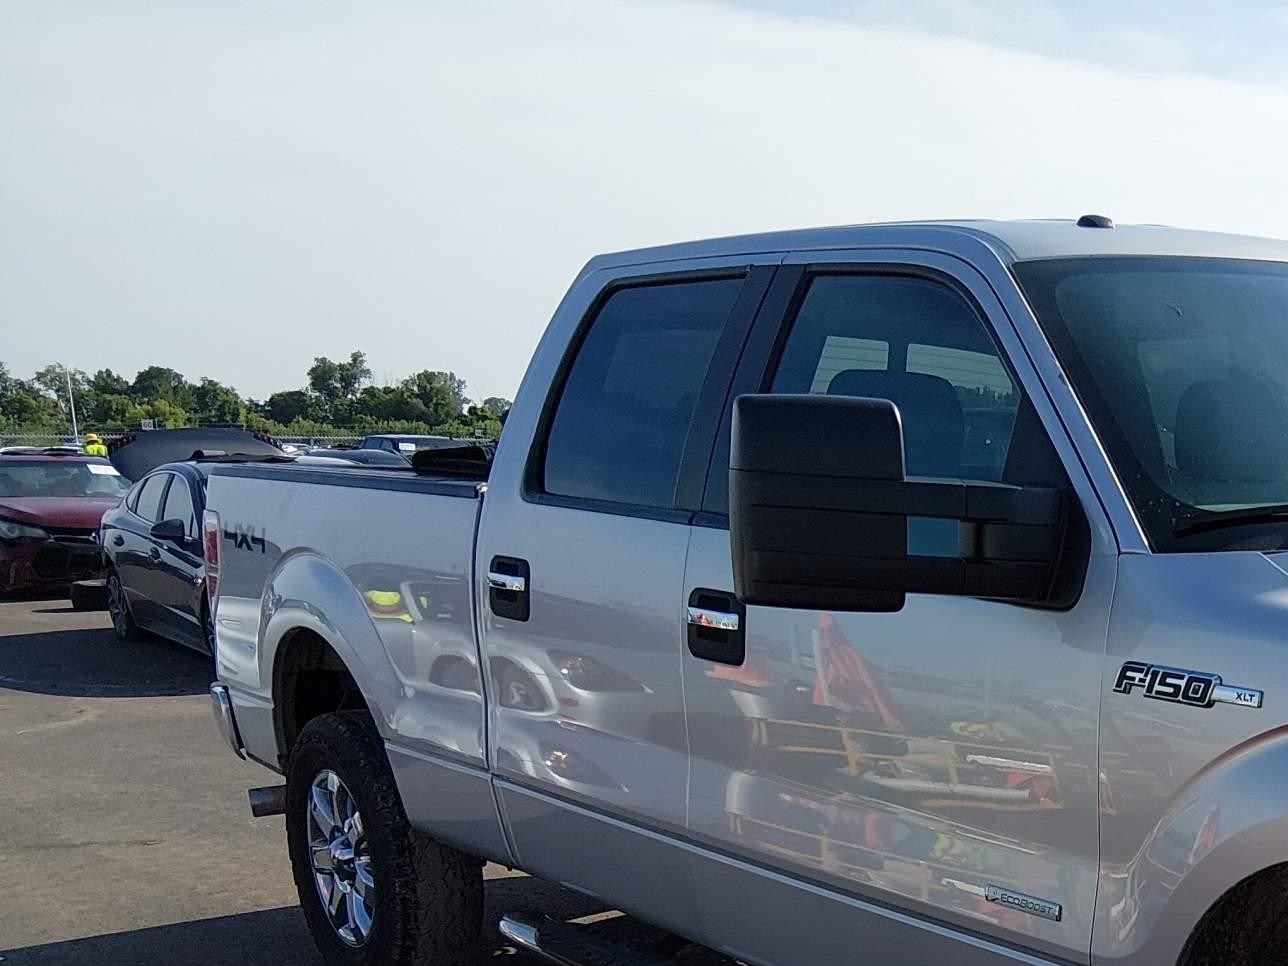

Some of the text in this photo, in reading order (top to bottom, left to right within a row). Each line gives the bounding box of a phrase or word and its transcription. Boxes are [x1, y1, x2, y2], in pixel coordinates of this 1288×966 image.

[1113, 661, 1256, 708] F-150 XLT
[1000, 893, 1054, 915] ECOBOOST
